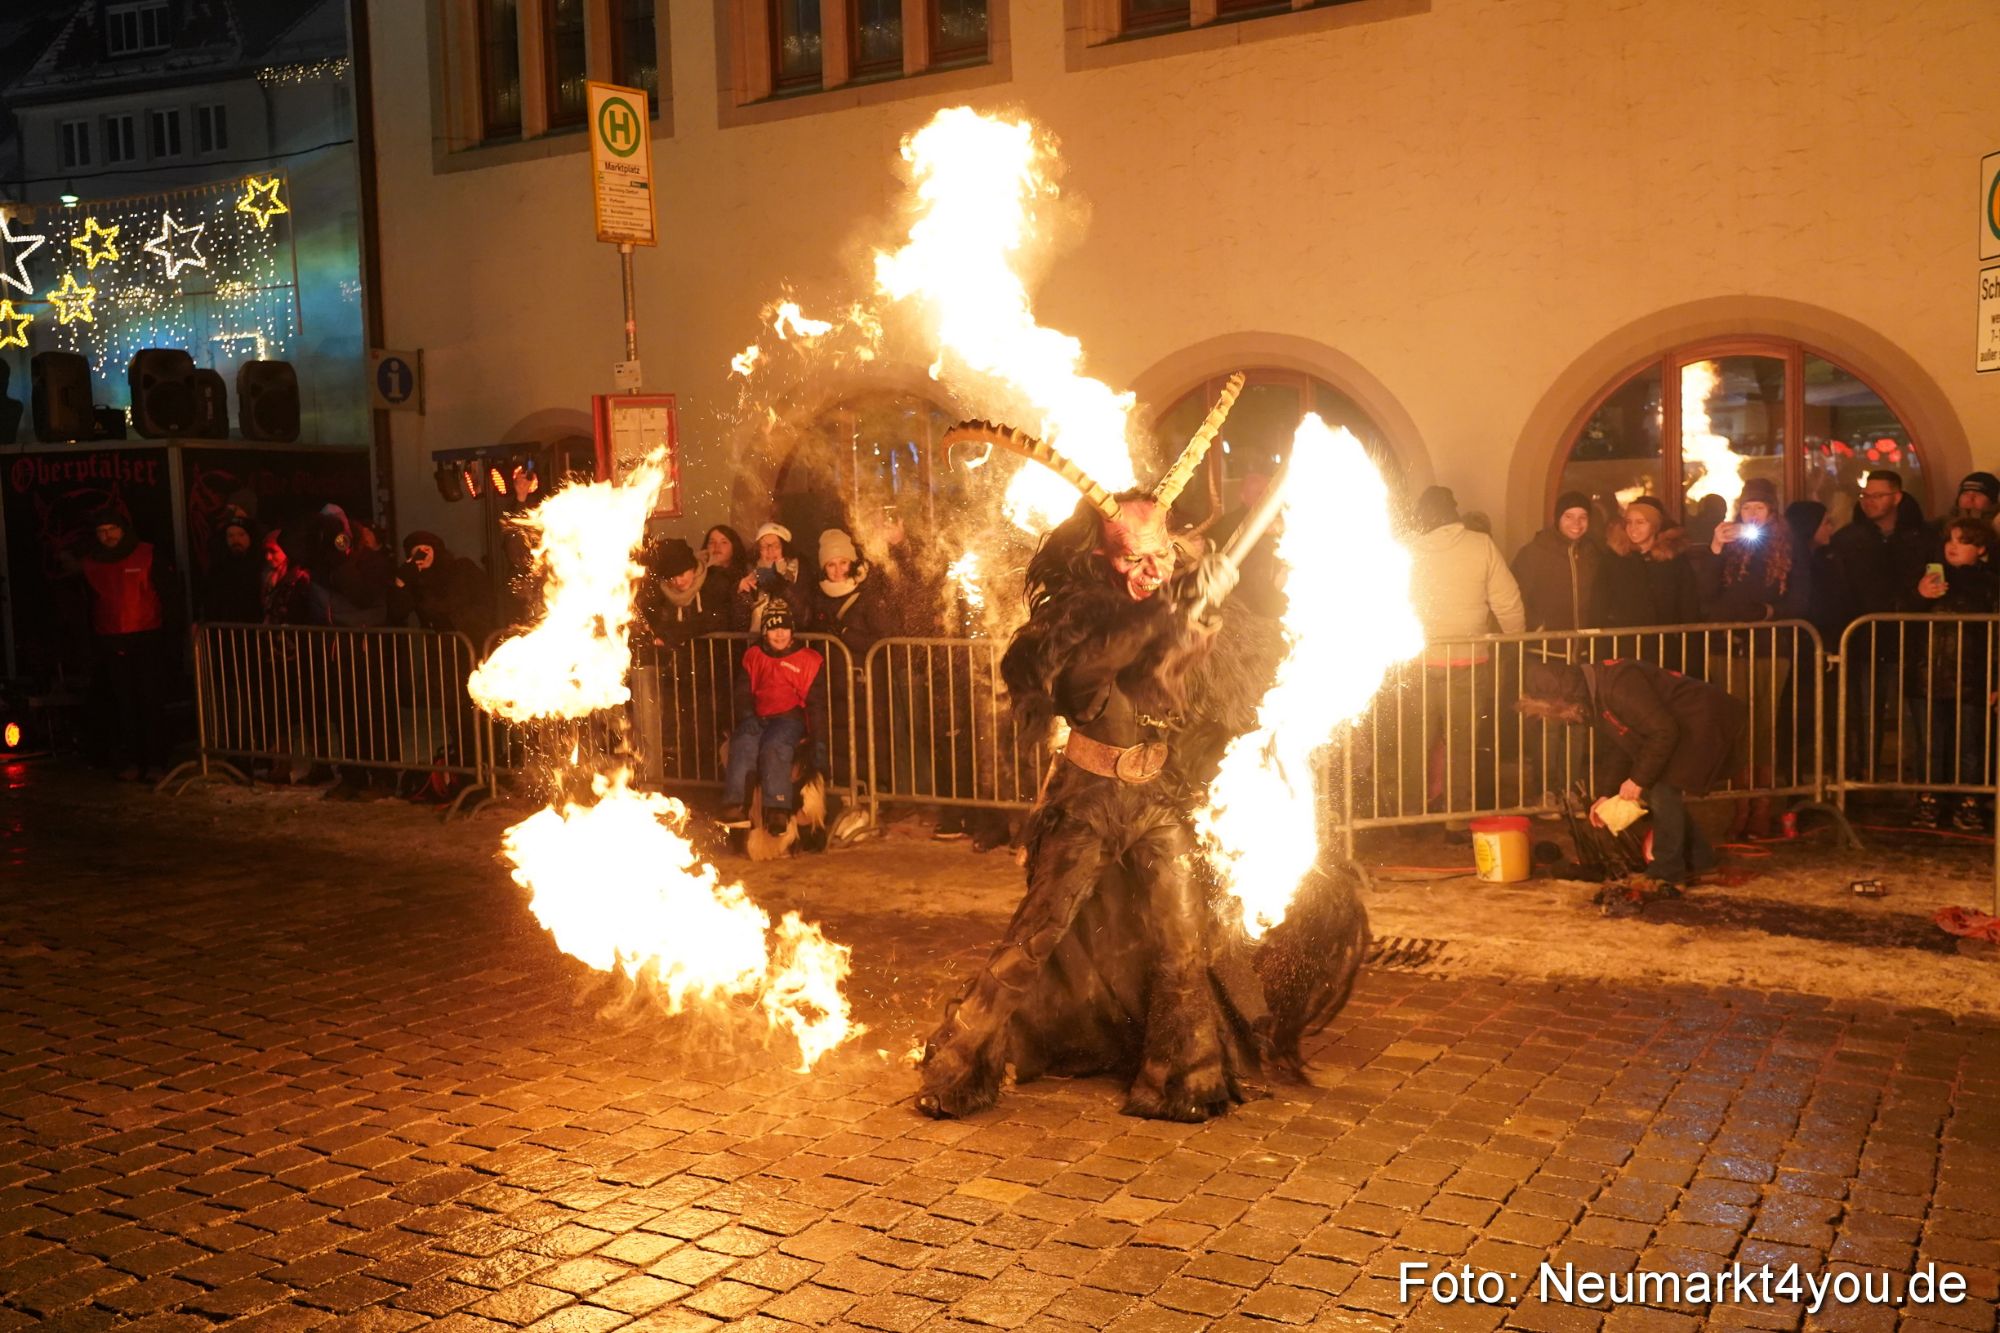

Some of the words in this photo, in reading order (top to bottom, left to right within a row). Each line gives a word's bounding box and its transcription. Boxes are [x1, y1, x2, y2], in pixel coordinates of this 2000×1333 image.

[609, 110, 630, 145] H
[605, 161, 640, 174] Marktplatz
[11, 451, 159, 493] Oberpfälzer
